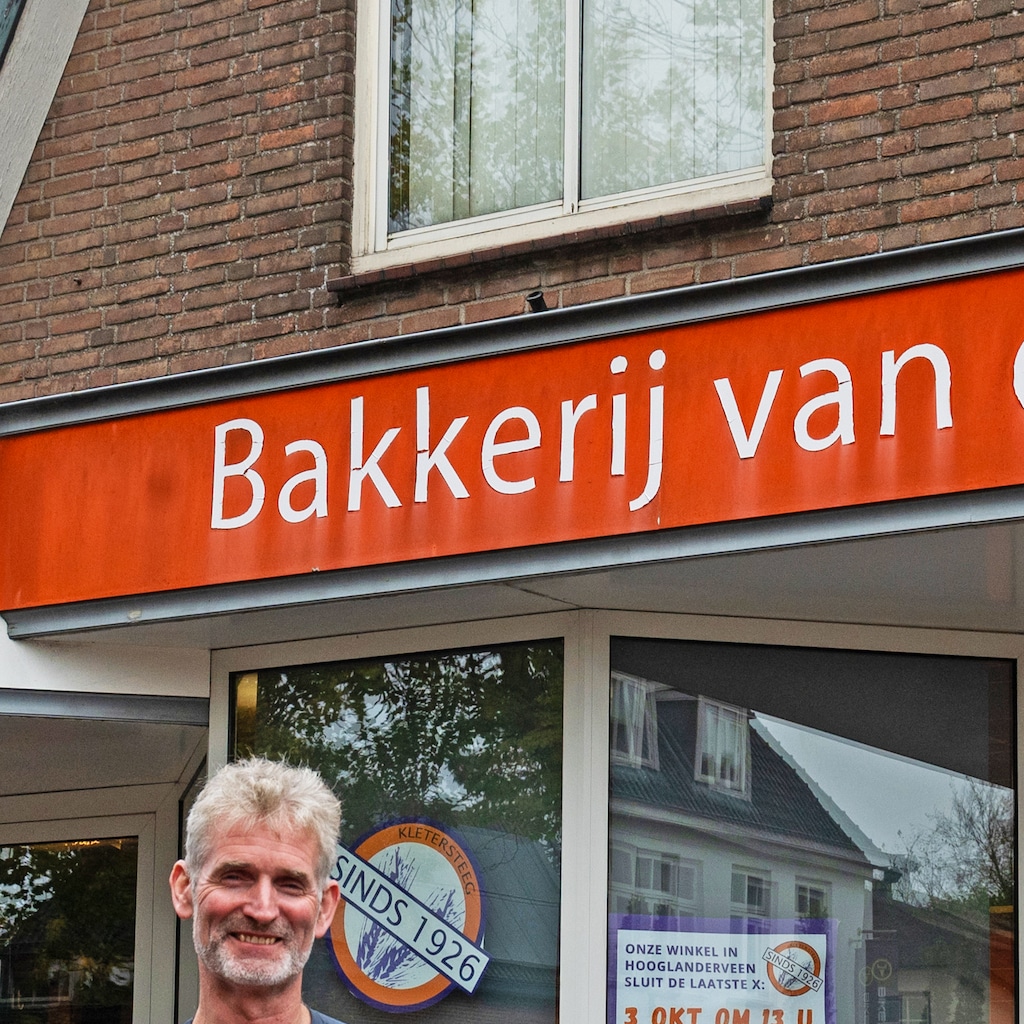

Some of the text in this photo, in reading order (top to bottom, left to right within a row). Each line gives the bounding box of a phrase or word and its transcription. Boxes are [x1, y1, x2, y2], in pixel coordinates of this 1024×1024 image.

[211, 349, 666, 530] Bakkerij
[713, 343, 953, 459] van
[398, 826, 476, 895] KLETERSTEEG
[330, 855, 480, 982] SINDS 1926
[625, 943, 738, 958] ONZE WINKEL IN
[625, 960, 756, 974] HOOGLANDERVEEN
[624, 977, 765, 990] SLUIT DE LAATSTE X:
[766, 951, 795, 973] SINDS
[797, 969, 820, 989] 1926
